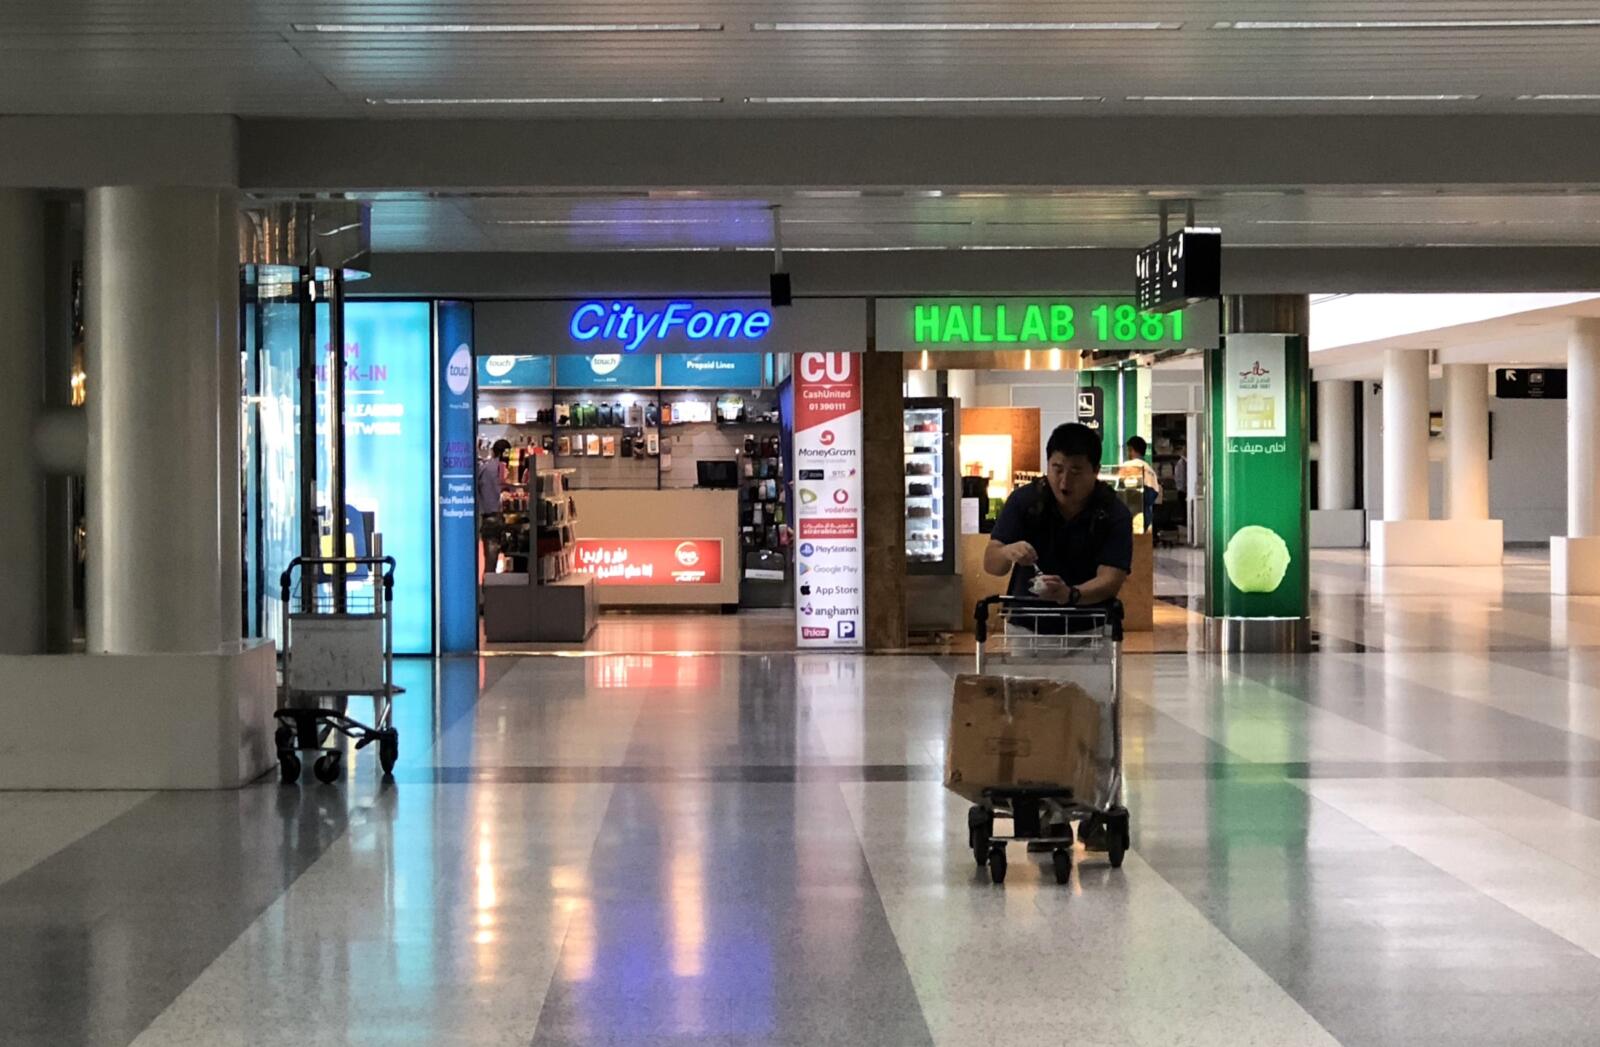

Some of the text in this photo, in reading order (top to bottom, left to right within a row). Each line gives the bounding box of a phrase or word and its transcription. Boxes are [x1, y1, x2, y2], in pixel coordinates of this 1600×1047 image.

[570, 302, 772, 350] CityFone
[914, 304, 1183, 342] HALLAB 1881
[593, 355, 617, 366] touch
[687, 360, 735, 371] Prepaid Lines
[801, 352, 851, 383] CU
[803, 390, 852, 399] CashUnited
[799, 447, 857, 458] MoneyGram
[815, 545, 857, 554] PlayStation
[814, 565, 858, 574] Google Play
[816, 586, 859, 596] App Store
[815, 605, 859, 619] anghami
